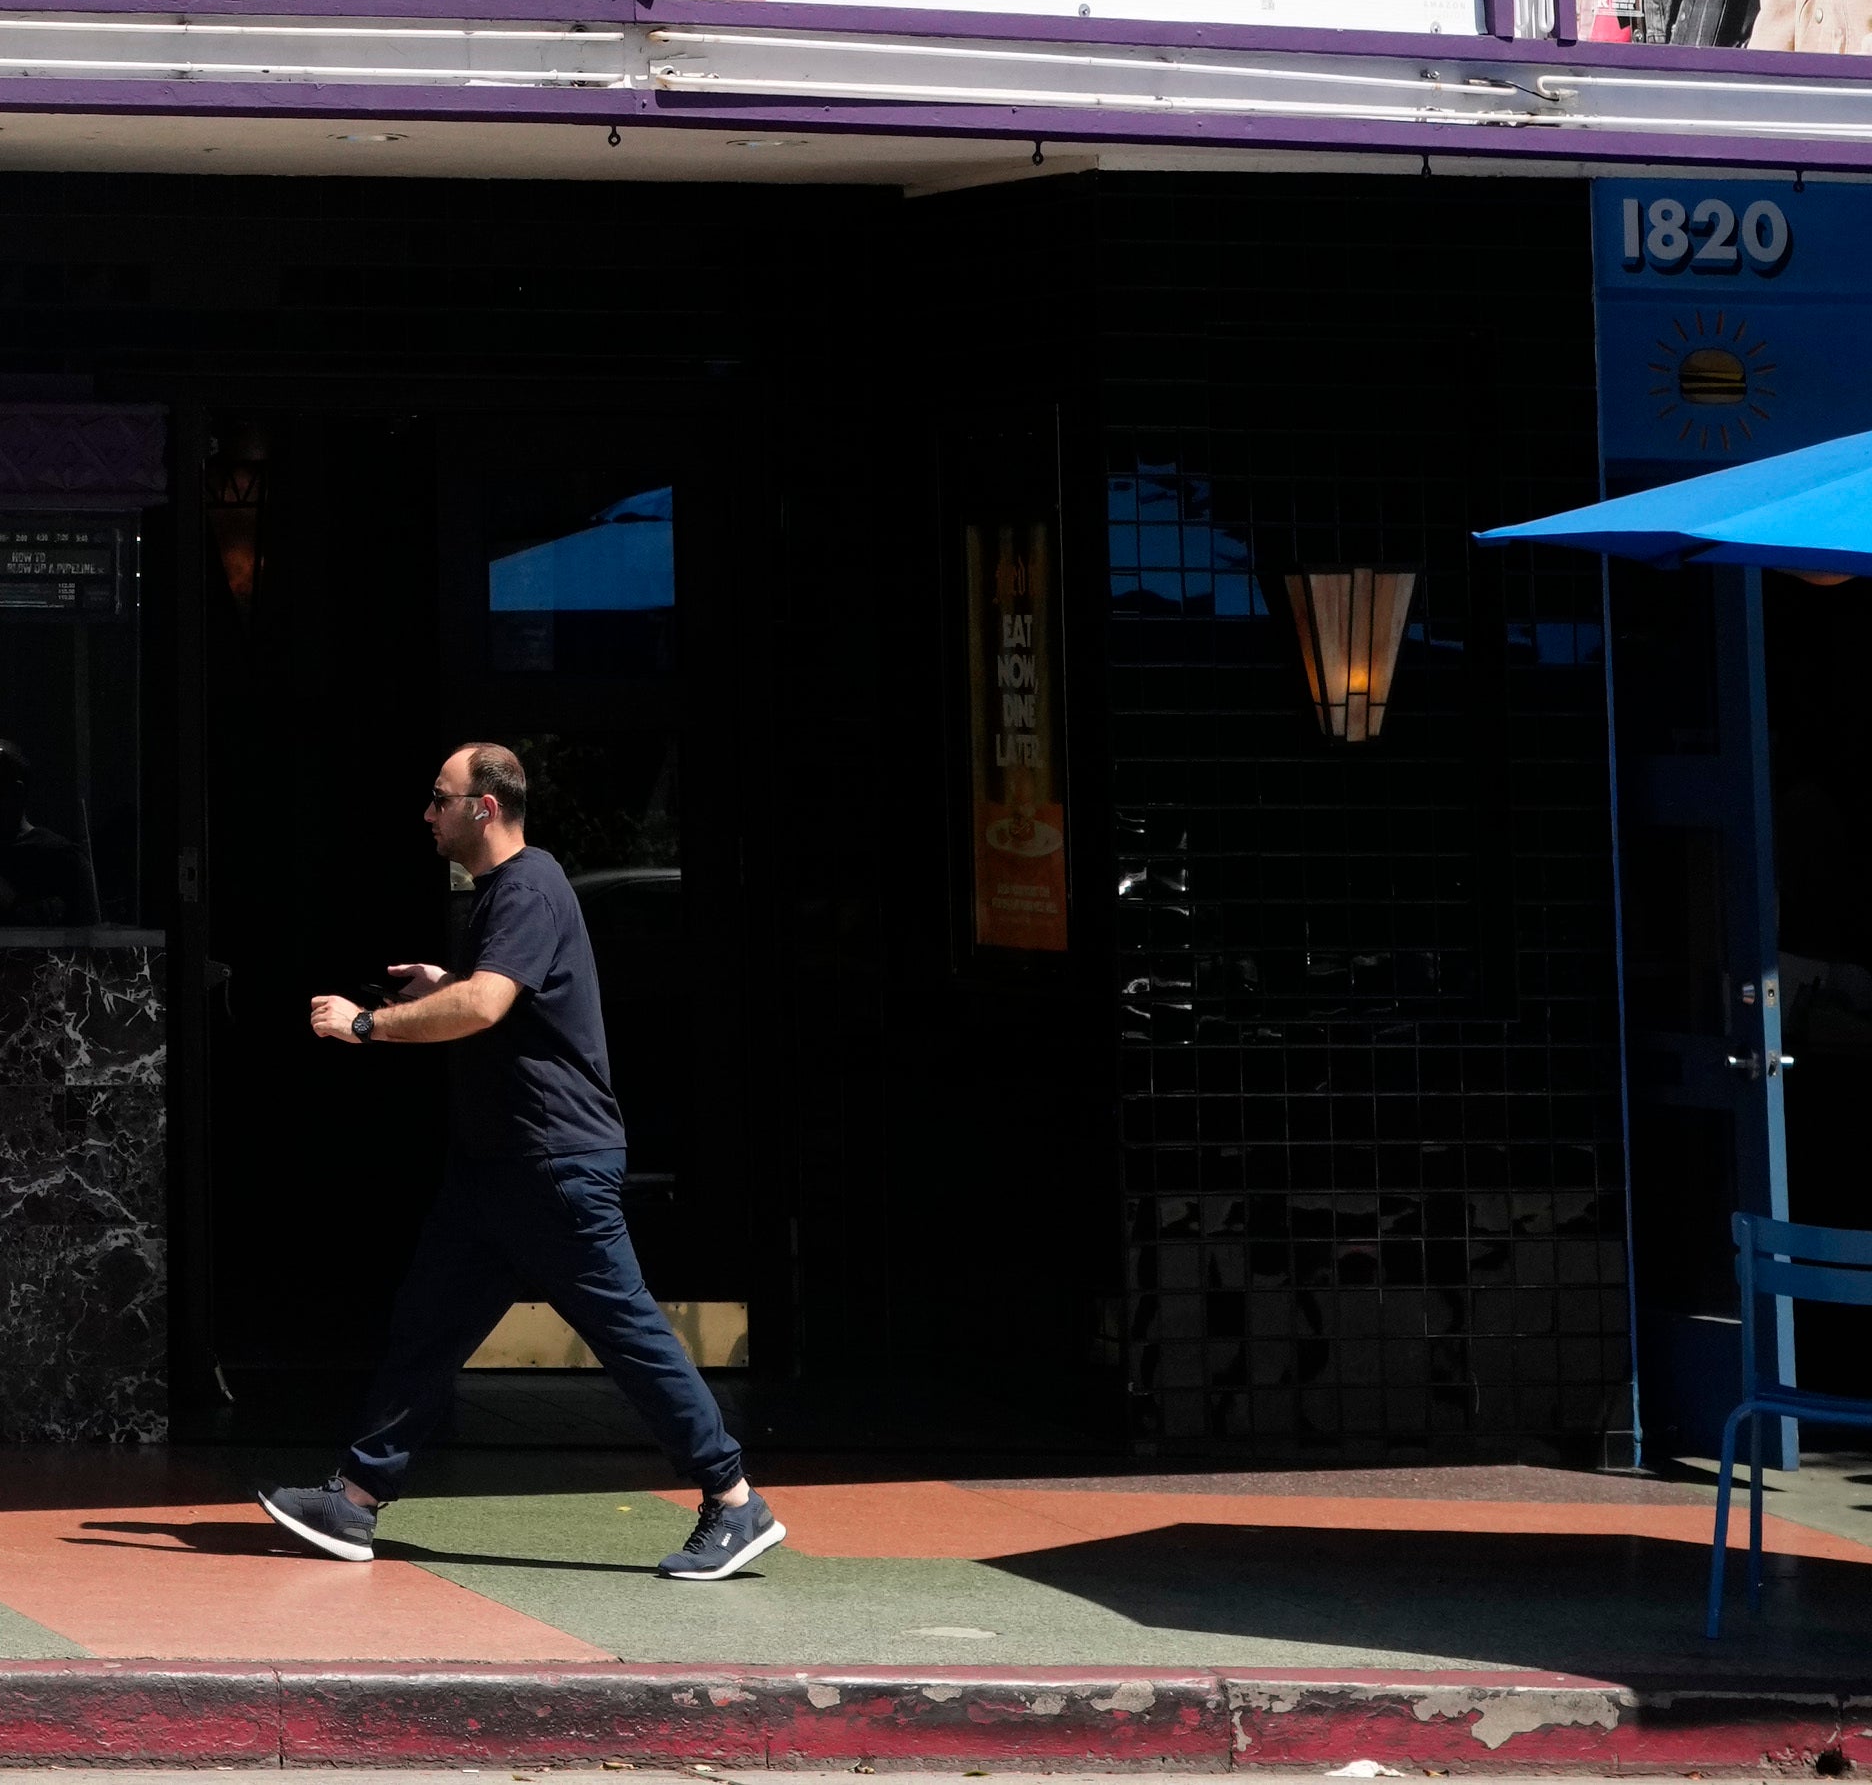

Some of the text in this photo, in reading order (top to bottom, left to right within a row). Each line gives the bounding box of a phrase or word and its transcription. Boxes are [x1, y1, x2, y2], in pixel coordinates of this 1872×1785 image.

[1622, 198, 1788, 263] 1820
[11, 551, 46, 563] HOW TO
[1002, 614, 1033, 648] EAT
[1002, 694, 1036, 728] DINE
